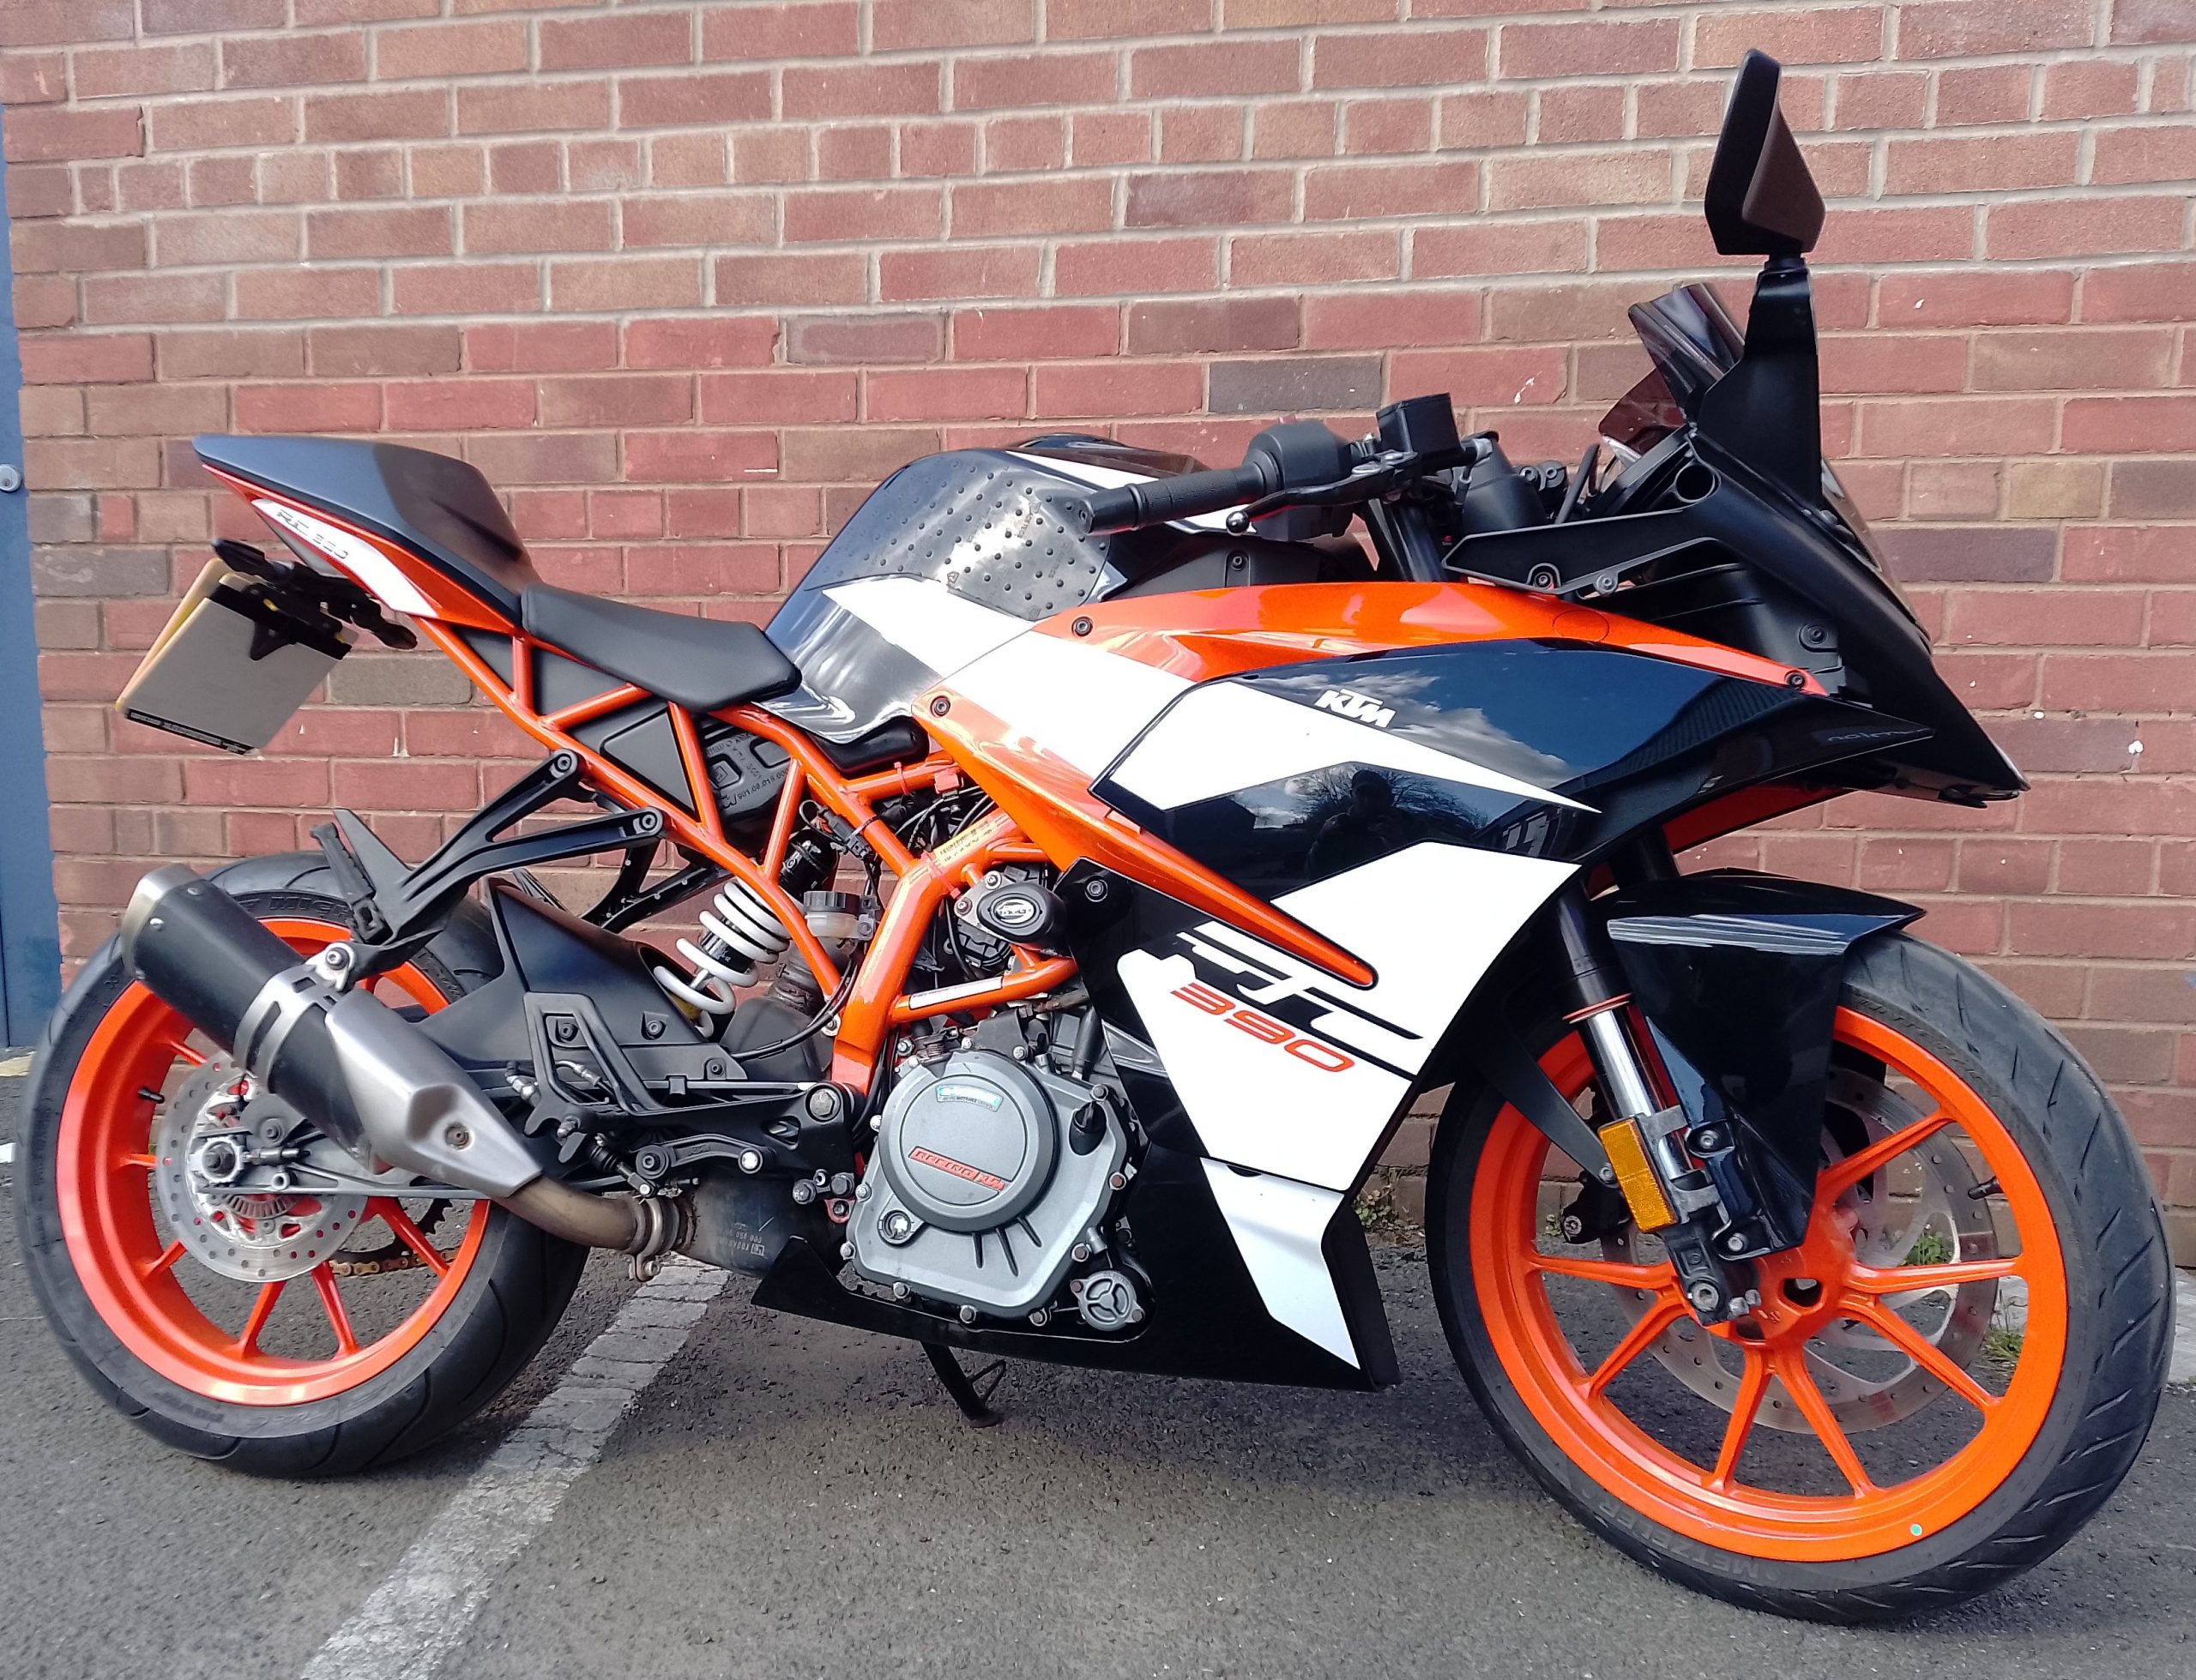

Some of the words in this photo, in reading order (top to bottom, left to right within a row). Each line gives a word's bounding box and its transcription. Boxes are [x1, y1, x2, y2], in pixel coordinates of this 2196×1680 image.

[1314, 688, 1397, 728] KTM
[1169, 982, 1355, 1072] 390
[1598, 1502, 1759, 1579] METZELER
